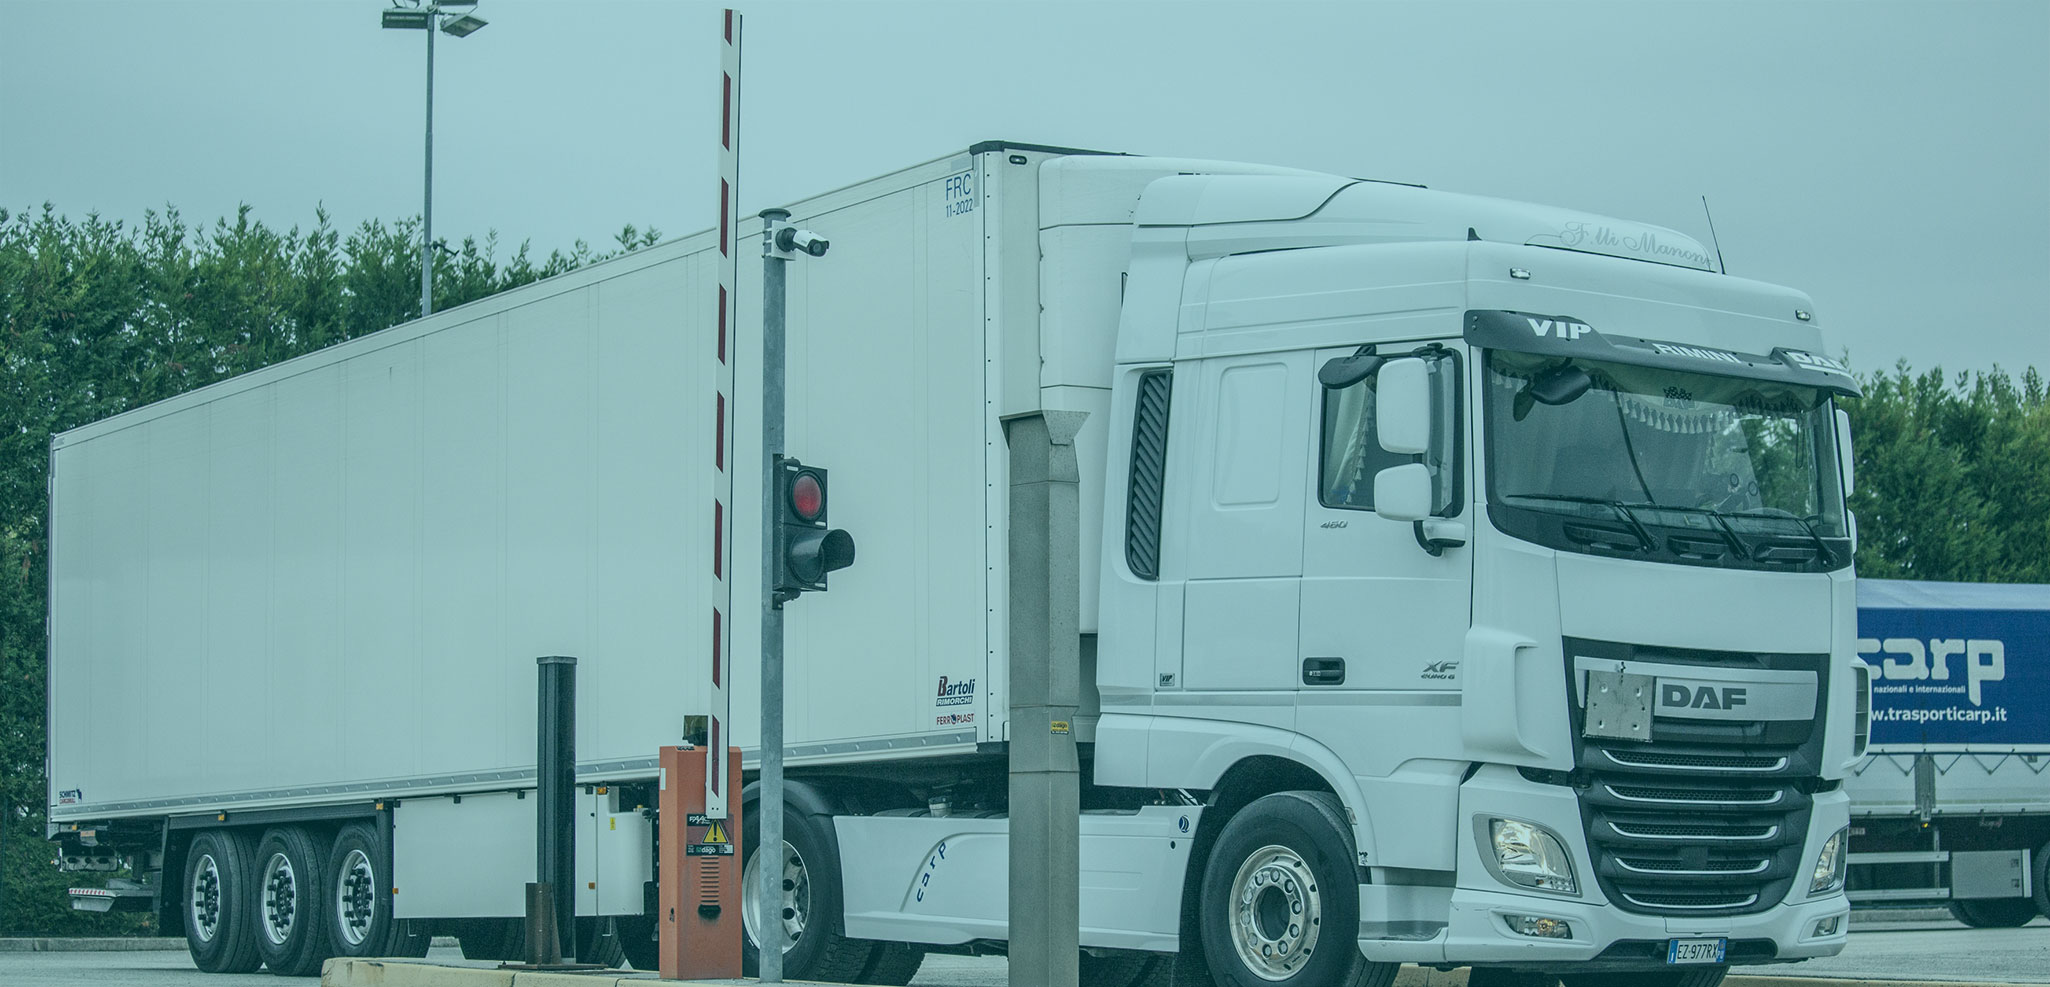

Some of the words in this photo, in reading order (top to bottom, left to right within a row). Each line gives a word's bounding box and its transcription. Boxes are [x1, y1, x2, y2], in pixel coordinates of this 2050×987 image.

[945, 173, 971, 201] FRC
[945, 198, 973, 218] 11-2022
[1527, 318, 1592, 340] VIP
[1652, 343, 1742, 364] RIMINI
[1422, 660, 1460, 673] XF
[1857, 638, 2005, 706] carp
[937, 675, 976, 697] Bartoli
[1161, 675, 1173, 683] VIP
[1874, 685, 1907, 694] nazionali
[1915, 685, 1966, 694] internazionali
[936, 696, 973, 706] RIMORCHI
[1662, 683, 1747, 711] DAF
[916, 841, 946, 902] carp
